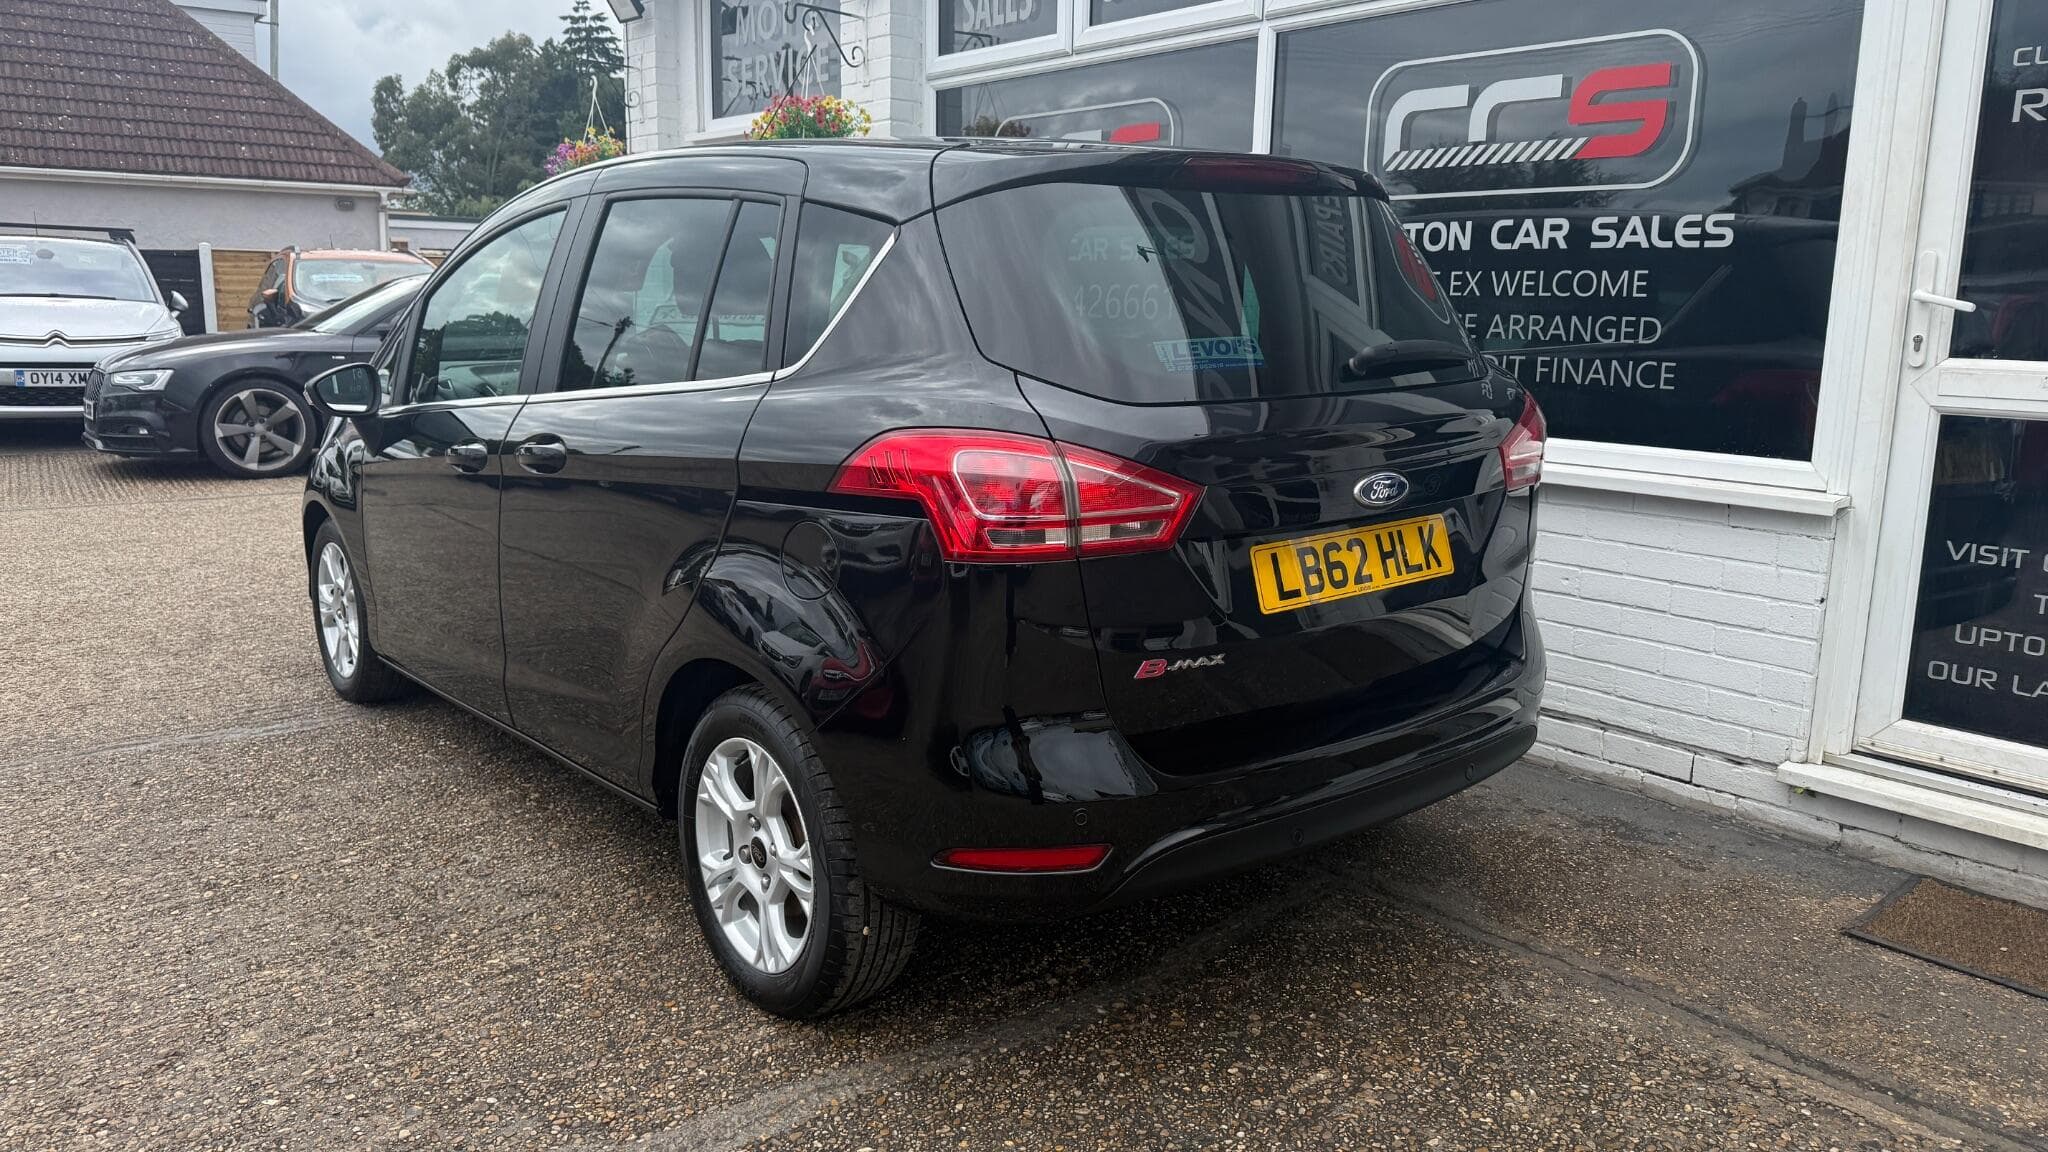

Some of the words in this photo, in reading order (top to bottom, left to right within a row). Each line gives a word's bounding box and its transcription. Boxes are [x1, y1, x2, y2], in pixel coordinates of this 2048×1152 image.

[727, 41, 829, 98] SERVICE
[1490, 217, 1570, 250] CAR
[1590, 213, 1736, 249] SALES
[1449, 270, 1482, 296] EX
[1491, 269, 1649, 297] WELCOME
[1486, 314, 1662, 344] ARRANGED
[30, 372, 64, 384] OY14
[68, 372, 91, 384] XM
[1535, 356, 1677, 390] FINANCE
[1370, 480, 1398, 500] Ford
[1270, 537, 1373, 601] LB62
[1375, 523, 1442, 579] HLK
[1947, 540, 2030, 569] VISIT
[1954, 623, 2046, 656] UPTO
[1134, 653, 1226, 679] B-MAX
[1927, 660, 1998, 690] OUR
